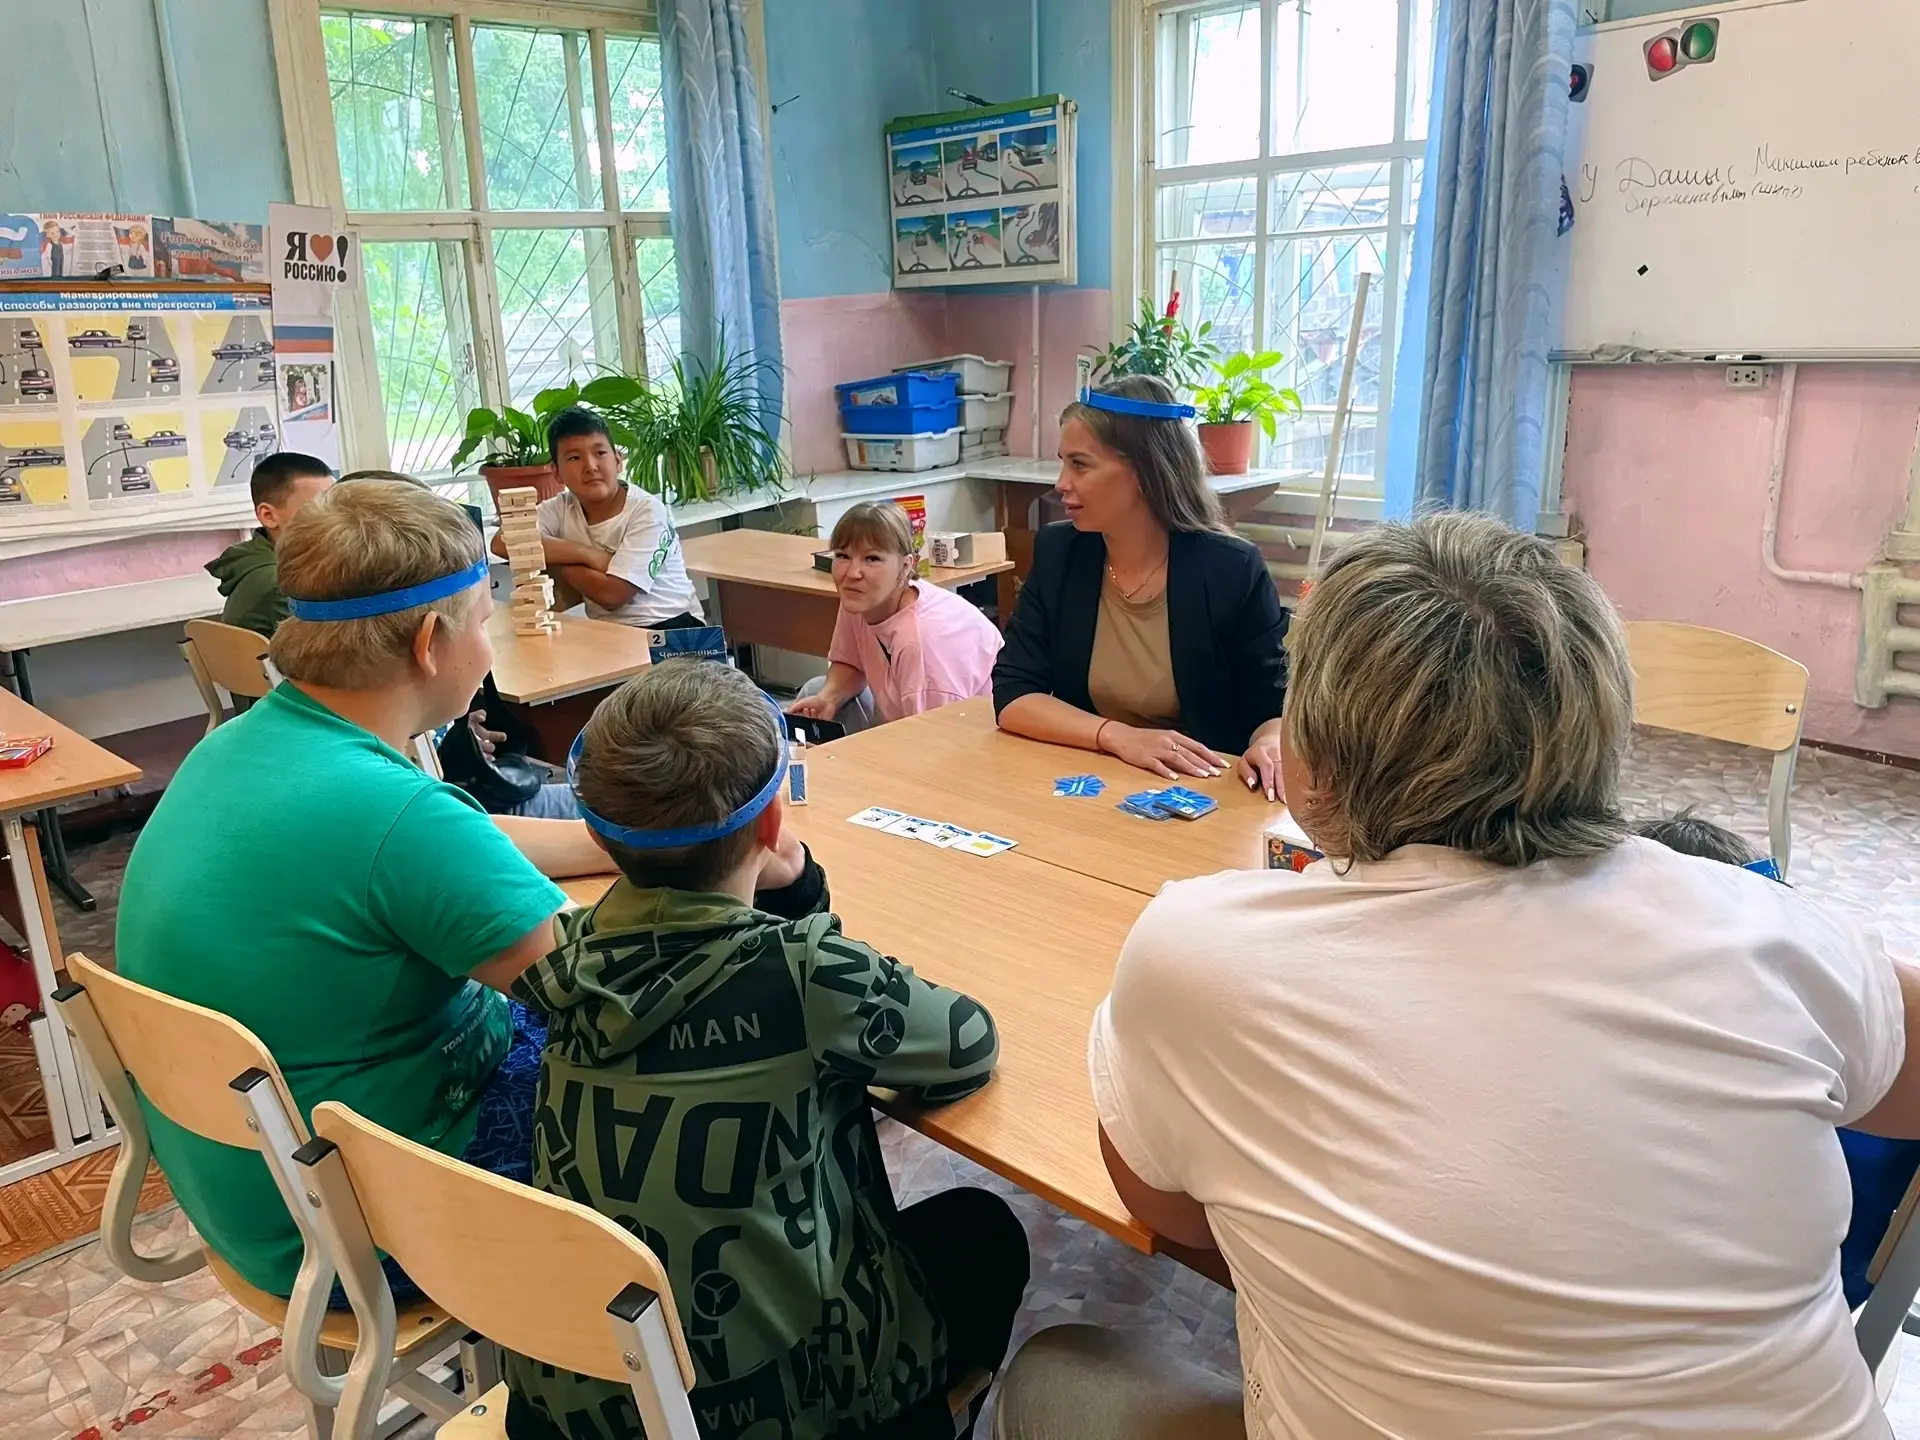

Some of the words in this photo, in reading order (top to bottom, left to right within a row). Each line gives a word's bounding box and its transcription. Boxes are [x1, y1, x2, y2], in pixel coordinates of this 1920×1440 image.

[285, 231, 308, 262] Я
[59, 301, 119, 311] разворота
[122, 301, 141, 309] вне
[144, 300, 217, 311] перекрестка)
[652, 634, 661, 645] 2
[669, 1012, 761, 1051] MAN
